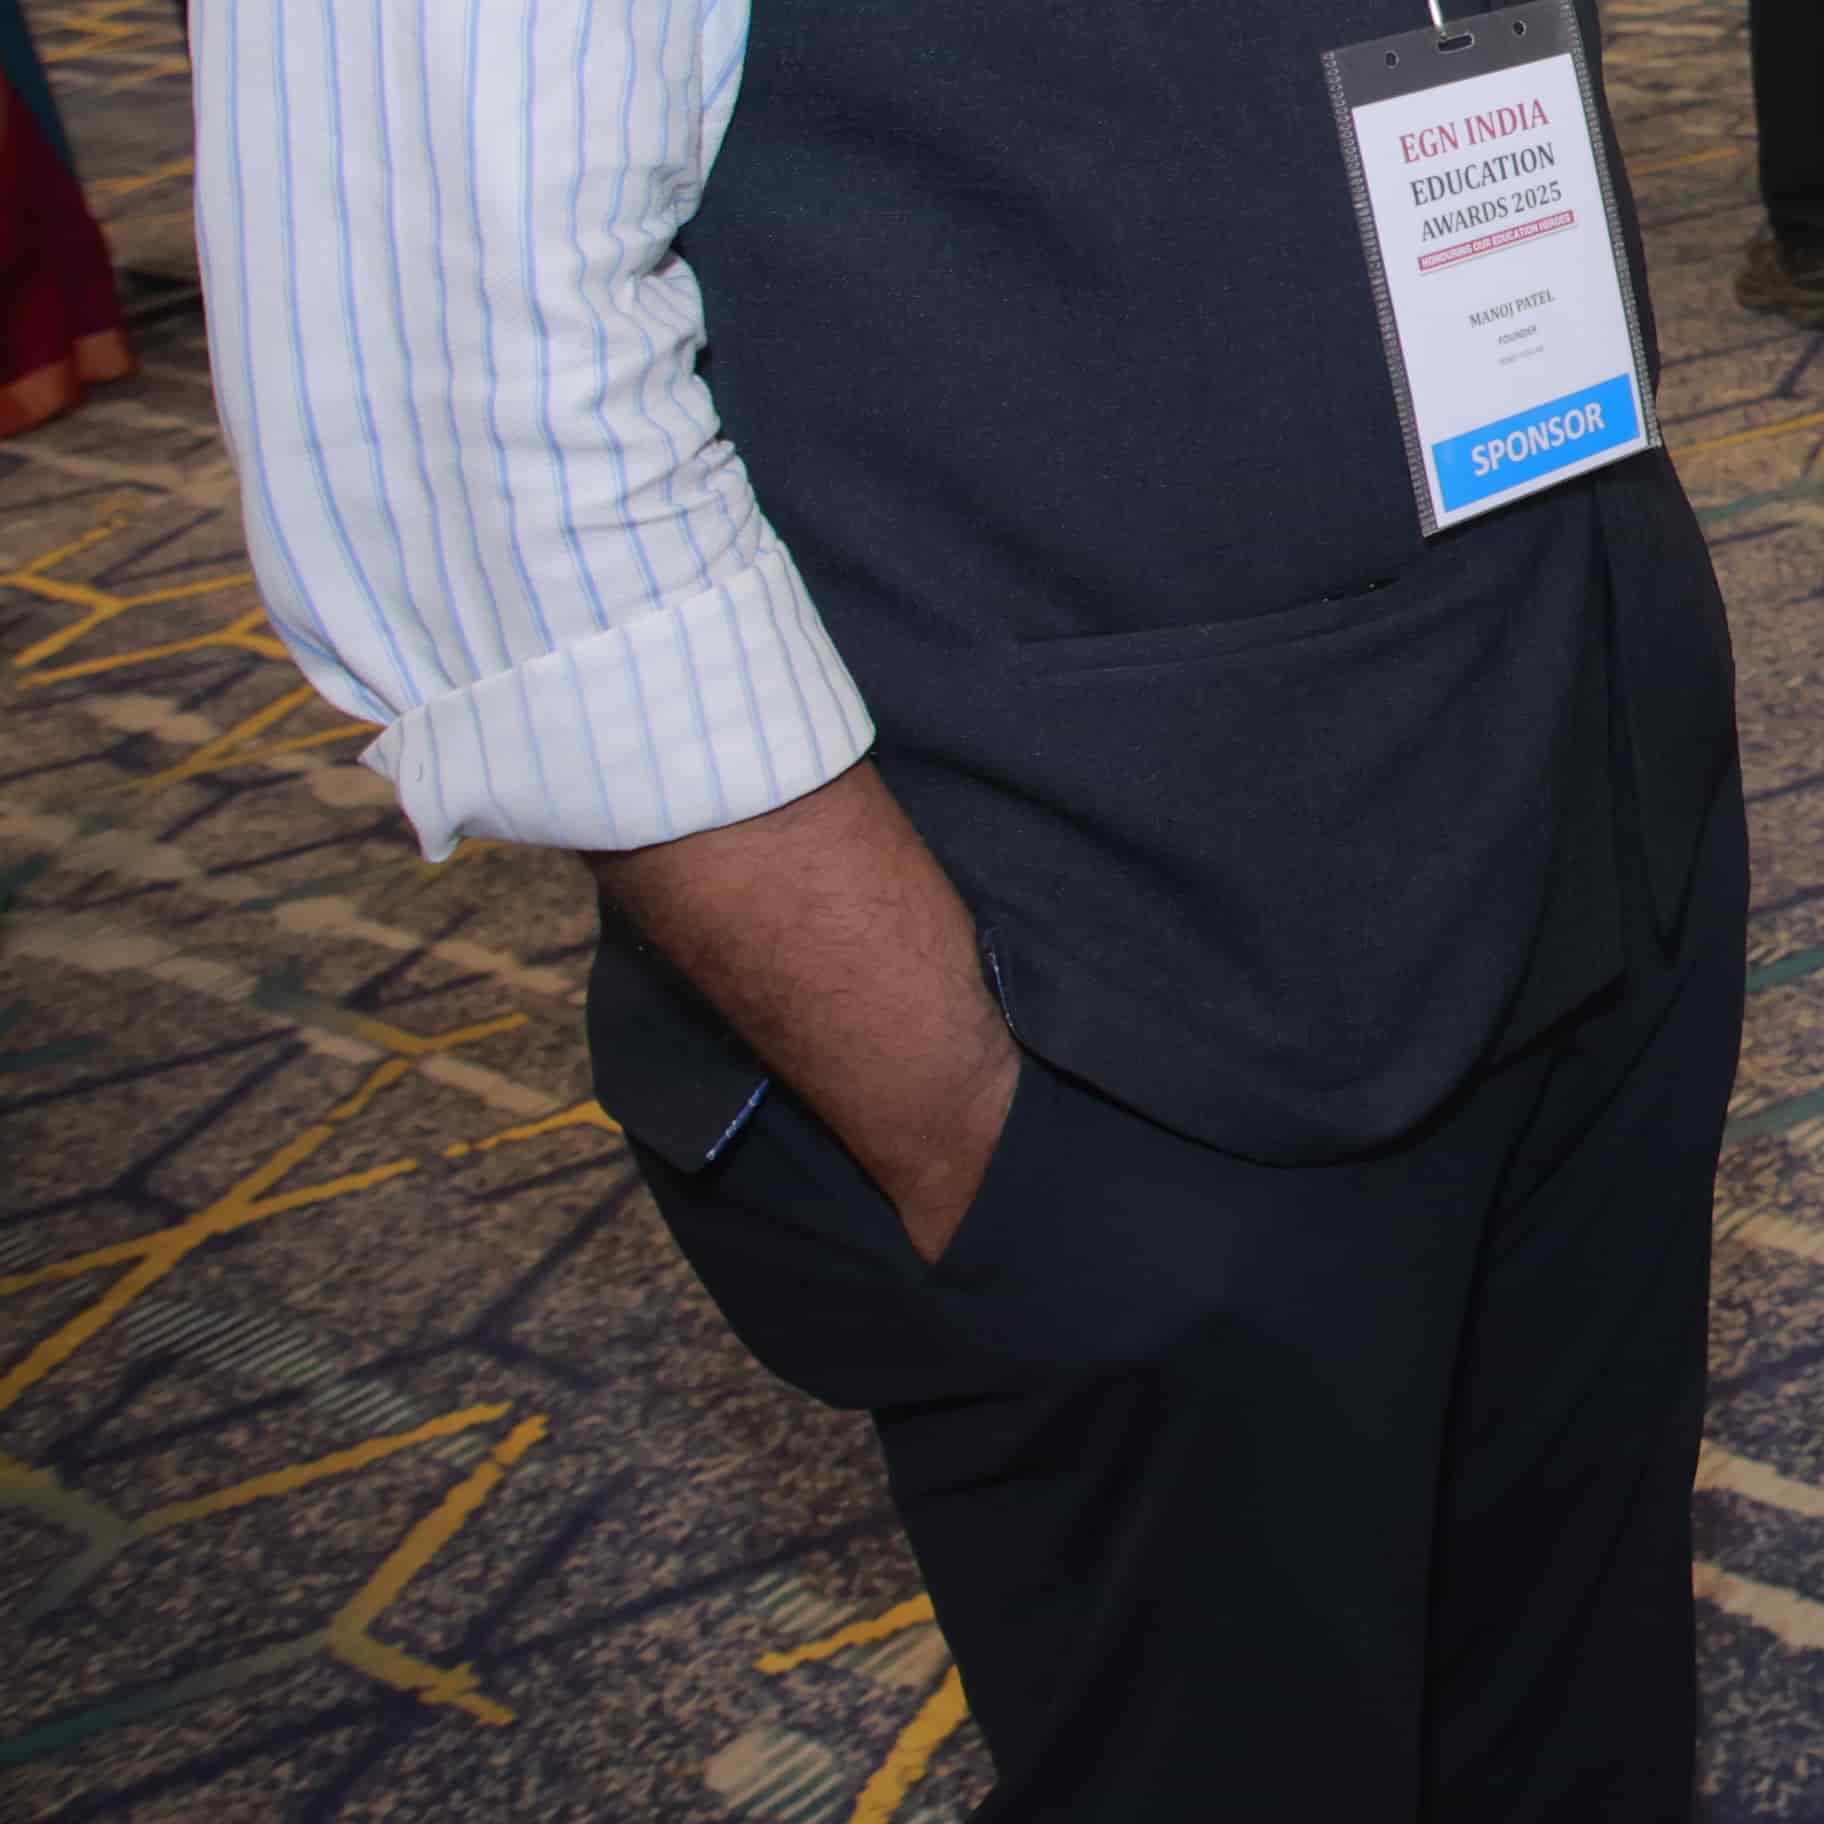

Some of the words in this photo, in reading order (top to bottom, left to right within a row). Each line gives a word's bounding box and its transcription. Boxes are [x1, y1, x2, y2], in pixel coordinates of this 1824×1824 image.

[1399, 119, 1463, 165] EGN
[1465, 98, 1550, 148] INDIA
[1408, 141, 1557, 208] EDUCATION
[1420, 198, 1510, 244] AWARDS
[1514, 181, 1563, 216] 2025
[1469, 302, 1514, 328] MANOJ
[1515, 287, 1557, 313] PATEL
[1470, 399, 1606, 479] SPONSOR
